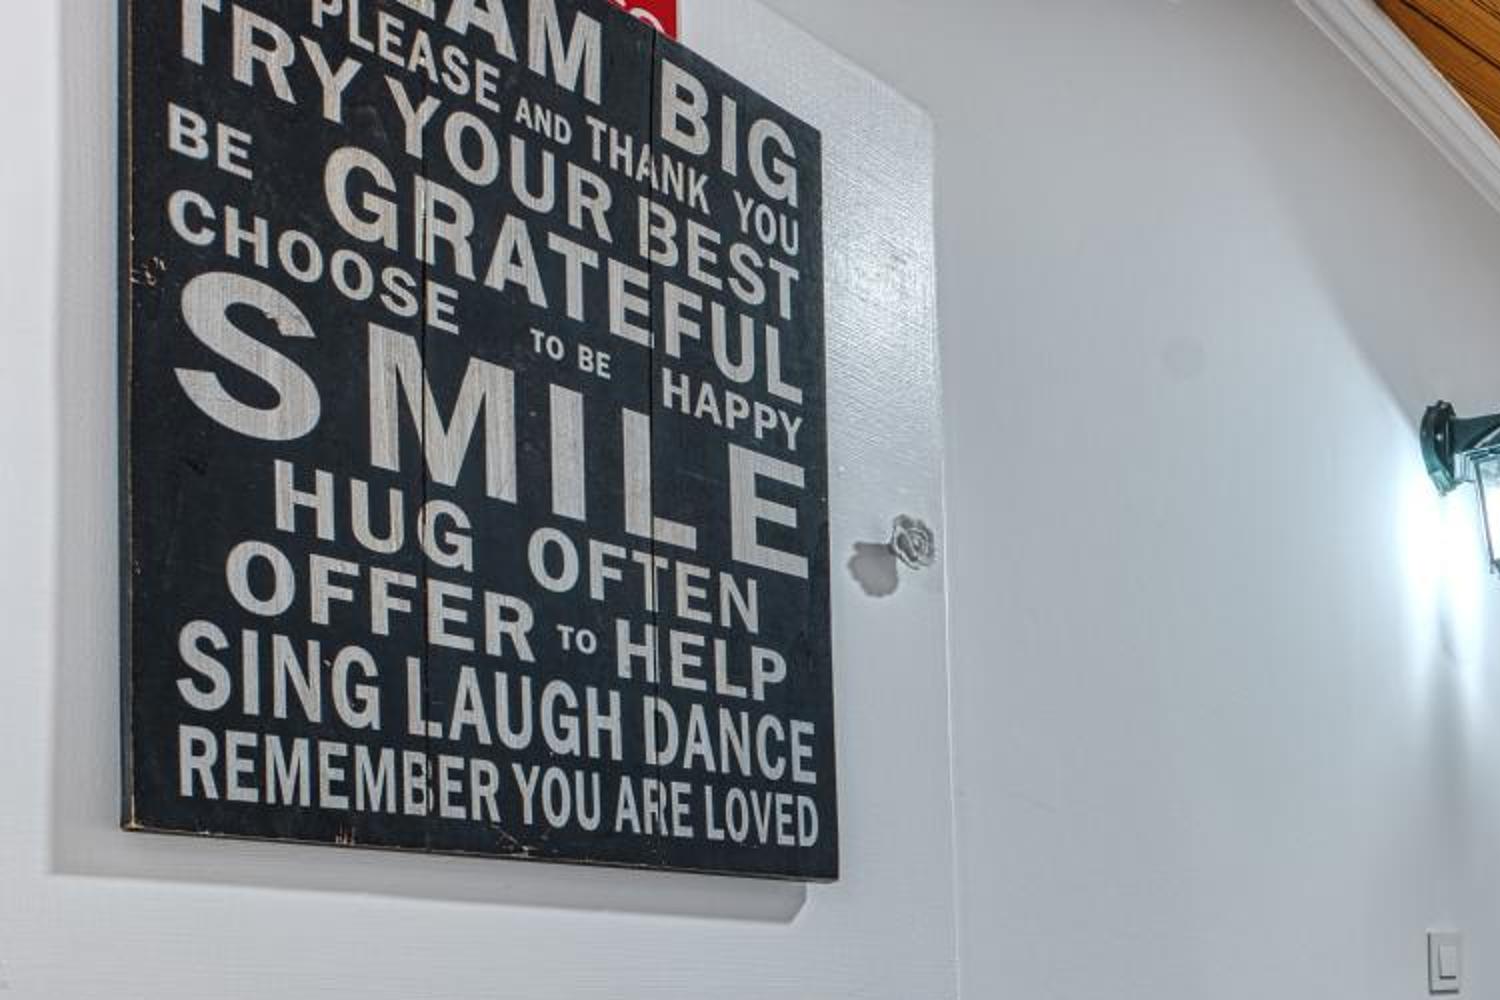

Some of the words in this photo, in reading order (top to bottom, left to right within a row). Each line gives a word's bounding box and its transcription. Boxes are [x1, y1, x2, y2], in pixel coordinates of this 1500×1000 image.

[178, 0, 362, 124] TRY
[384, 73, 613, 244] YOUR
[638, 195, 799, 320] BEST
[310, 0, 500, 112] PLEASE
[516, 101, 572, 145] AND
[587, 120, 708, 215] THANK
[733, 191, 798, 257] YOU
[660, 58, 798, 207] BIG
[167, 101, 252, 180] BE
[325, 145, 804, 405] GRATEFUL
[167, 189, 460, 335] CHOOSE
[531, 328, 565, 363] TO
[578, 344, 611, 380] BE
[662, 367, 803, 450] HAPPY
[174, 270, 808, 579] SMILE
[225, 540, 536, 663] OFFER
[557, 625, 597, 655] TO
[616, 618, 787, 702] HELP
[274, 459, 474, 573] HUG
[528, 527, 759, 633] OFTEN
[176, 618, 380, 731] SING
[406, 655, 622, 762] LAUGH
[643, 695, 817, 785] DANCE
[178, 723, 500, 824] REMEMBER
[513, 762, 600, 833] YOU
[616, 776, 694, 838] ARE
[706, 784, 819, 849] LOVED
